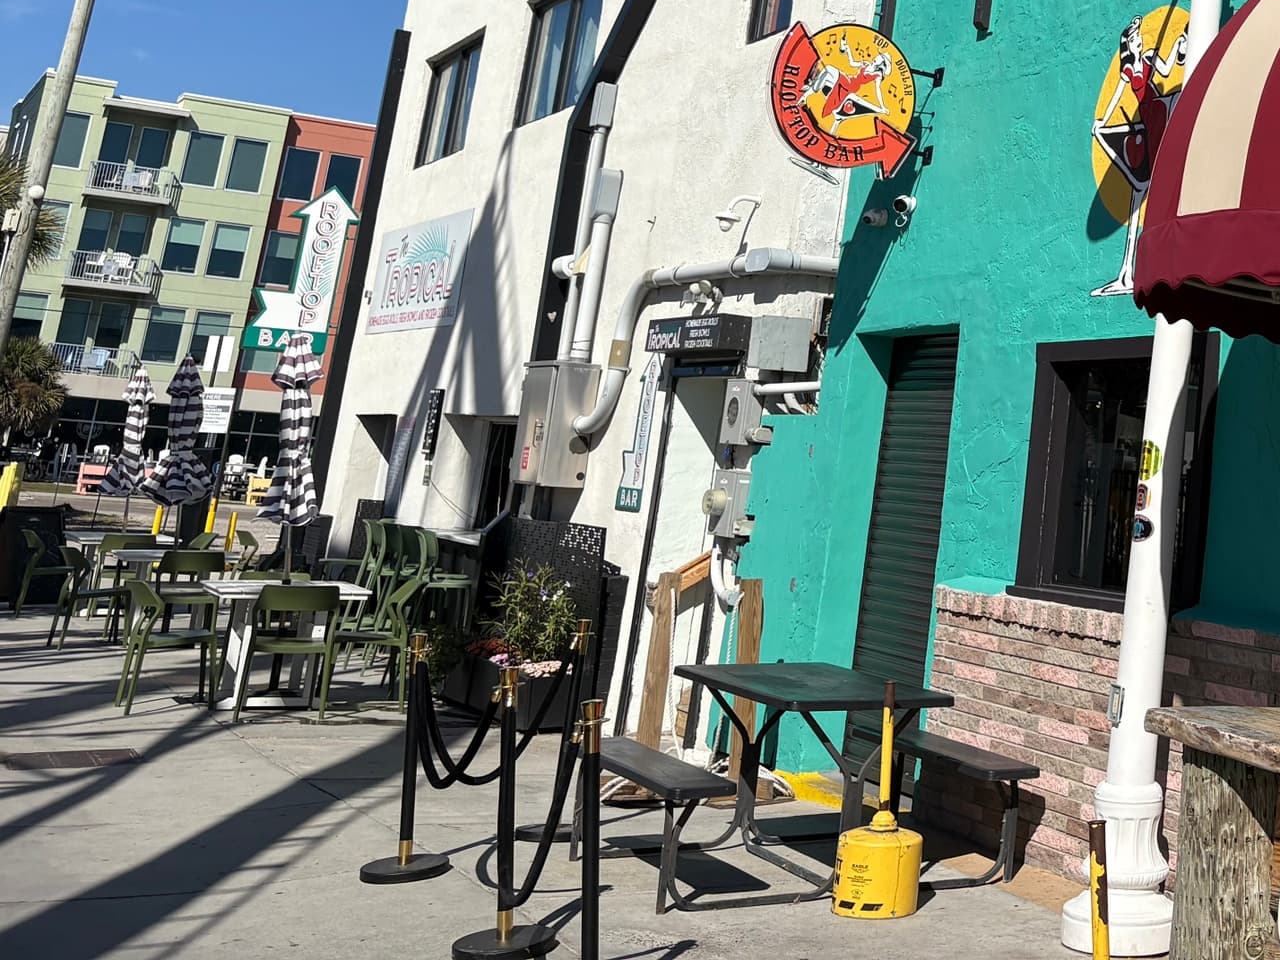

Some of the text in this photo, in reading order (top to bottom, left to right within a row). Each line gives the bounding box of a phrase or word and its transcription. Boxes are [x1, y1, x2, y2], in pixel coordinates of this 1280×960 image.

[872, 34, 890, 50] TOP
[894, 58, 913, 97] DOLLAR
[781, 63, 865, 162] ROOFTOP BAR
[299, 201, 338, 328] ROOFTOP
[647, 326, 682, 350] TROPICAL
[620, 489, 638, 508] BAR
